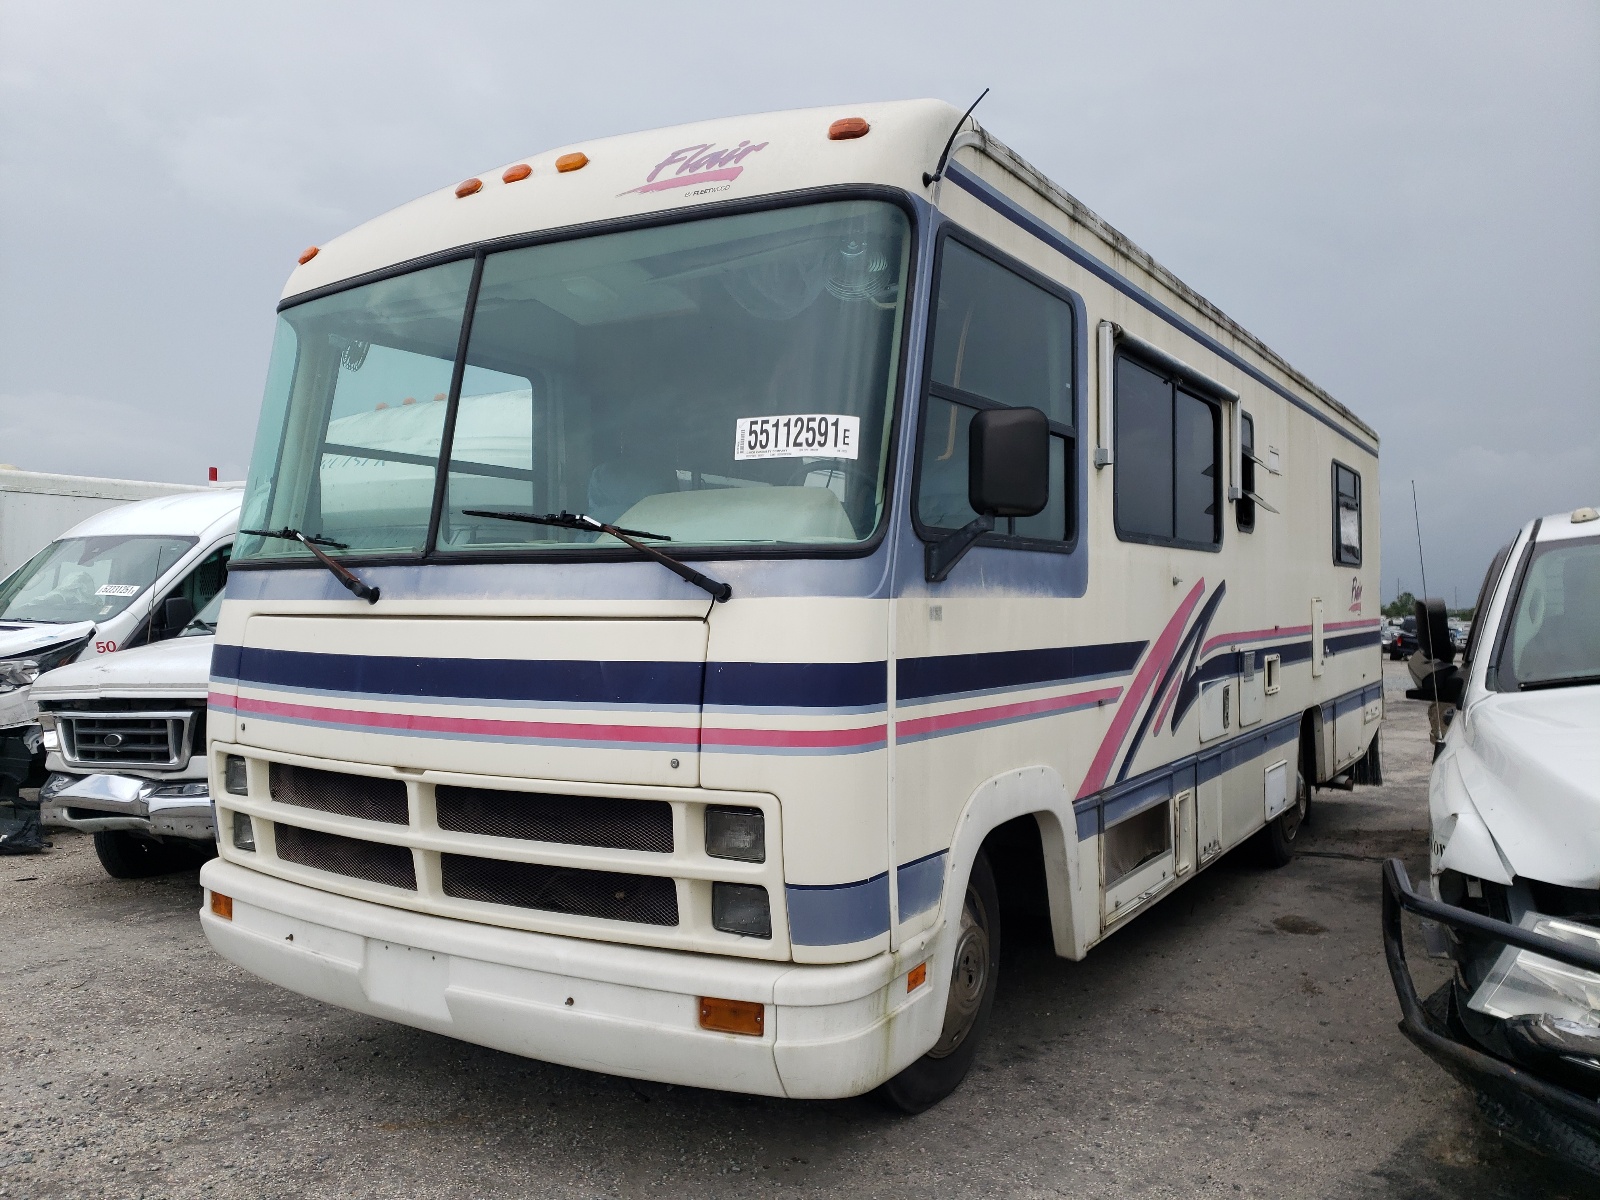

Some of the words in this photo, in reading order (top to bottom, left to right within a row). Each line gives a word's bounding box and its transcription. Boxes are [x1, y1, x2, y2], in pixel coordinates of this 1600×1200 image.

[647, 140, 769, 183] Flair
[748, 416, 840, 450] 55112591
[843, 429, 850, 446] E
[95, 640, 117, 654] 50
